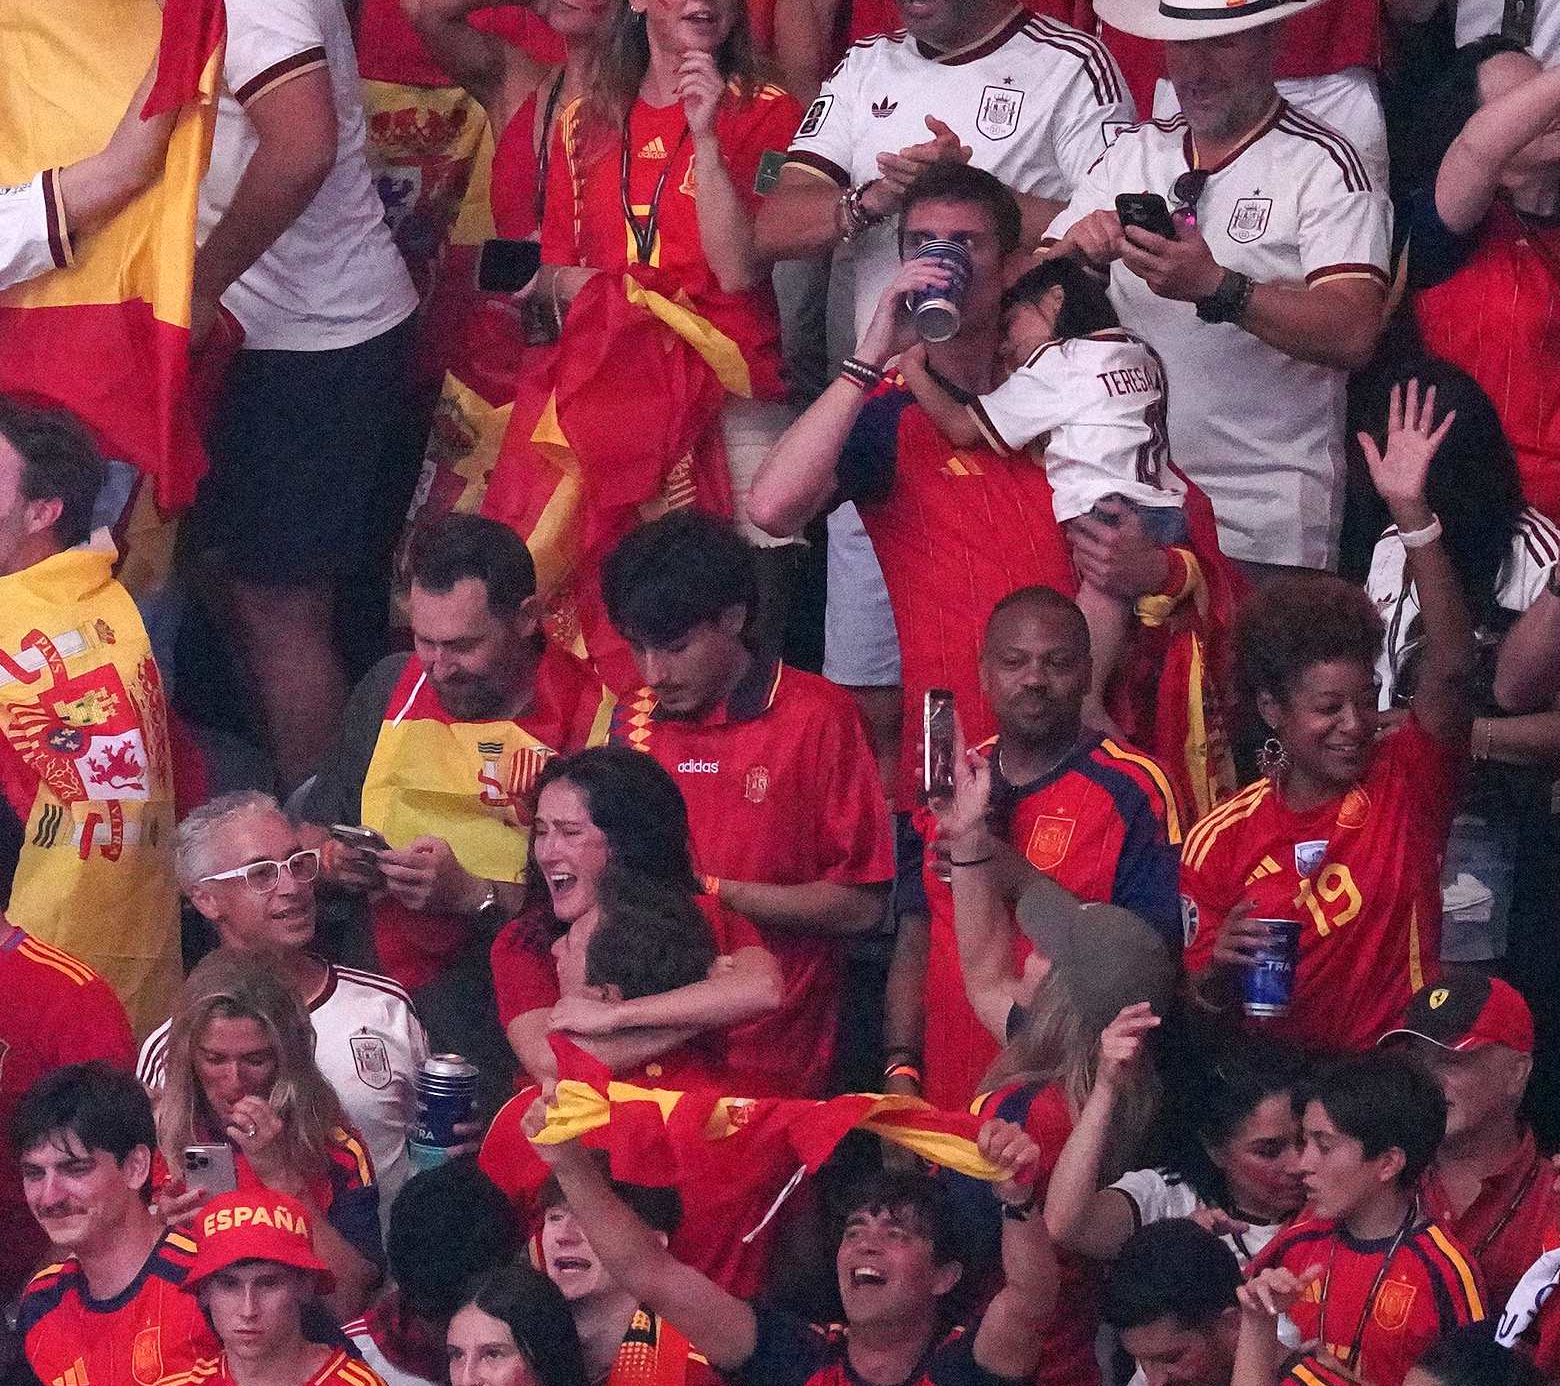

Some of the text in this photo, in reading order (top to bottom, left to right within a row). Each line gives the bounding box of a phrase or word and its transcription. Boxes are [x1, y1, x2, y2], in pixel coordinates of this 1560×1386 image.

[677, 758, 720, 774] adidas
[1292, 862, 1364, 937] 19
[203, 1205, 308, 1239] ESPAÑA
